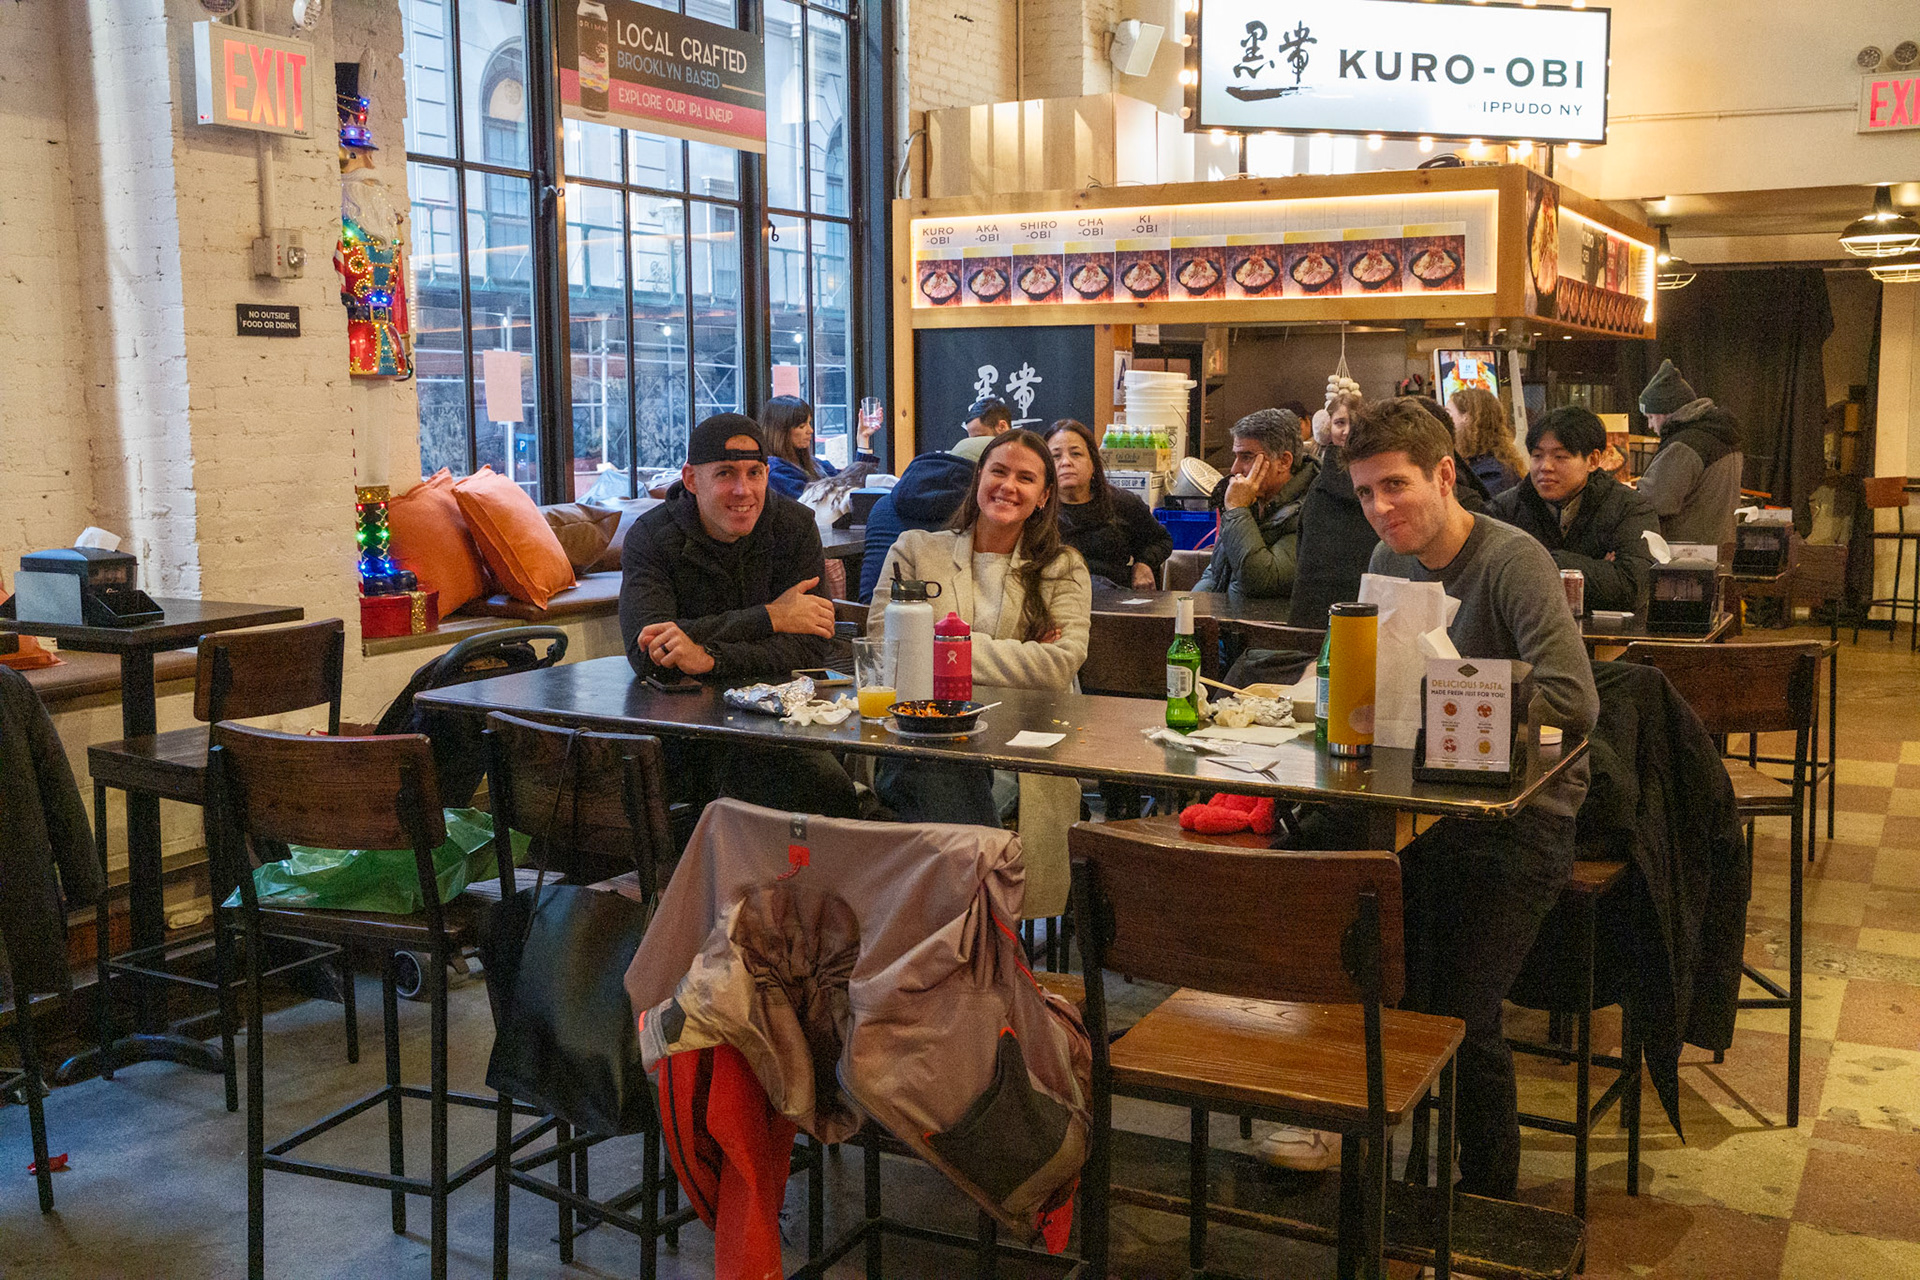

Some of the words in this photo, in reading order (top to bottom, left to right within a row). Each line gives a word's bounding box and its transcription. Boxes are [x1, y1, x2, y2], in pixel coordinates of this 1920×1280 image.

[617, 19, 674, 57] LOCAL
[680, 37, 747, 74] CRAFTED
[617, 50, 682, 81] BROOKLYN
[685, 66, 720, 90] BASED
[1339, 48, 1583, 89] KURO-OBI
[223, 39, 307, 131] EXIT
[618, 87, 662, 110] EXPLORE
[665, 97, 686, 115] OUR
[689, 102, 702, 119] IPA
[705, 106, 733, 124] LINEUP
[1483, 101, 1552, 116] IPPUDO
[1559, 104, 1584, 117] NY
[1078, 218, 1104, 227] CHA
[1139, 215, 1151, 224] KI
[975, 224, 999, 233] AKA
[1020, 220, 1057, 231] SHIRO
[1131, 224, 1158, 234] -OBI
[922, 226, 955, 236] KURO
[1025, 230, 1051, 240] -OBI
[1078, 227, 1104, 237] -OBI
[926, 236, 950, 245] -OBI
[975, 233, 1000, 242] -OBI
[248, 310, 260, 319] NO
[260, 311, 290, 320] OUTSIDE
[242, 320, 263, 328] FOOD
[263, 321, 275, 329] OR
[275, 322, 297, 330] DRINK
[519, 440, 526, 451] P
[1121, 479, 1131, 487] SIDE
[1132, 479, 1139, 487] UP
[1431, 680, 1477, 689] DELICIOUS
